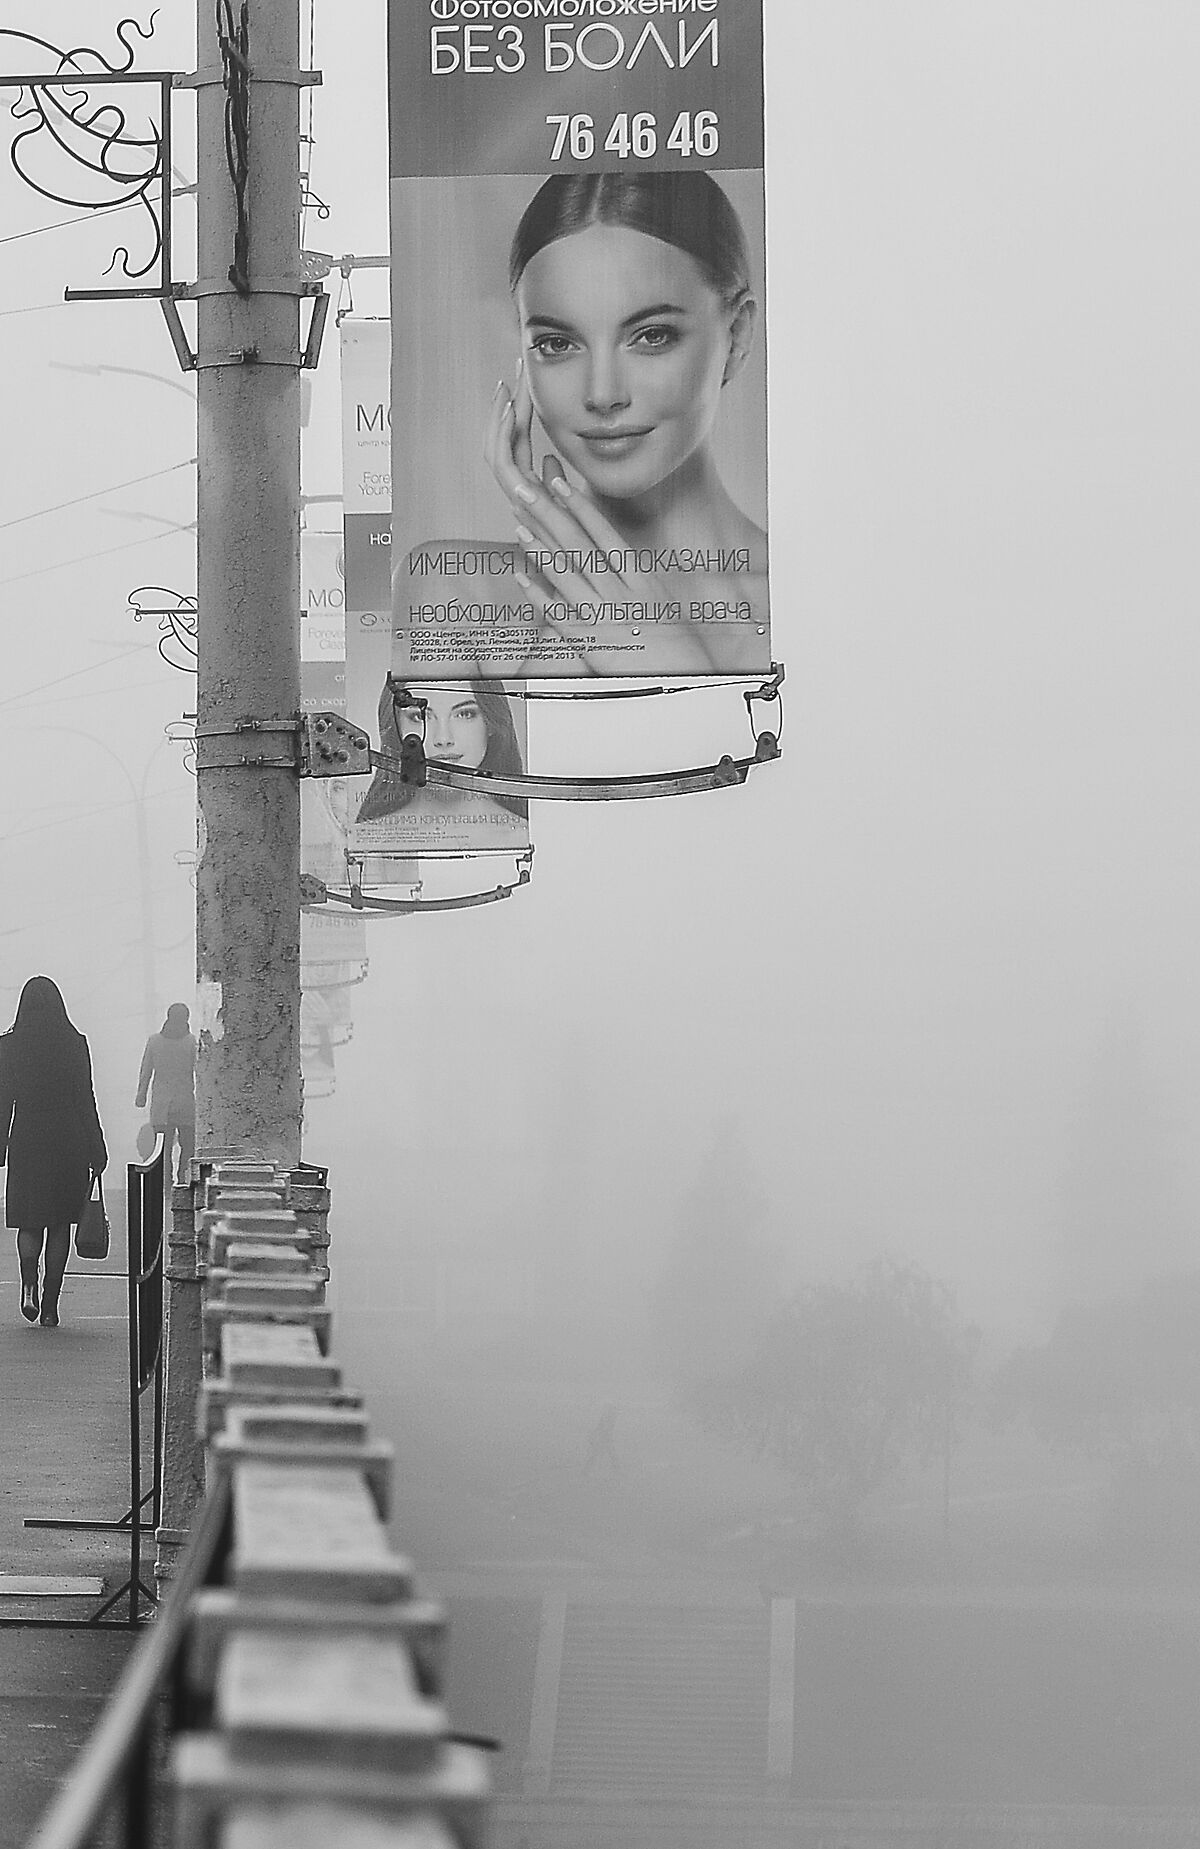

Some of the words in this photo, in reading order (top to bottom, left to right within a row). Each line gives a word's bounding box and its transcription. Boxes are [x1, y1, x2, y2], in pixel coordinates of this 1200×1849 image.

[430, 25, 526, 74] БЕЗ
[545, 18, 718, 72] БОЛИ
[546, 114, 594, 160] 76
[604, 112, 657, 158] 46
[667, 110, 719, 157] 46
[356, 404, 392, 432] М
[409, 551, 514, 576] ИМЕЮТСЯ
[525, 549, 750, 574] ПРОТИВОПОКАЗАНИЯ
[409, 598, 534, 625] необходима
[543, 601, 681, 626] консультация
[690, 601, 751, 622] врача
[410, 631, 431, 639] ООО
[469, 629, 489, 637] ИНН
[556, 652, 576, 660] 2013
